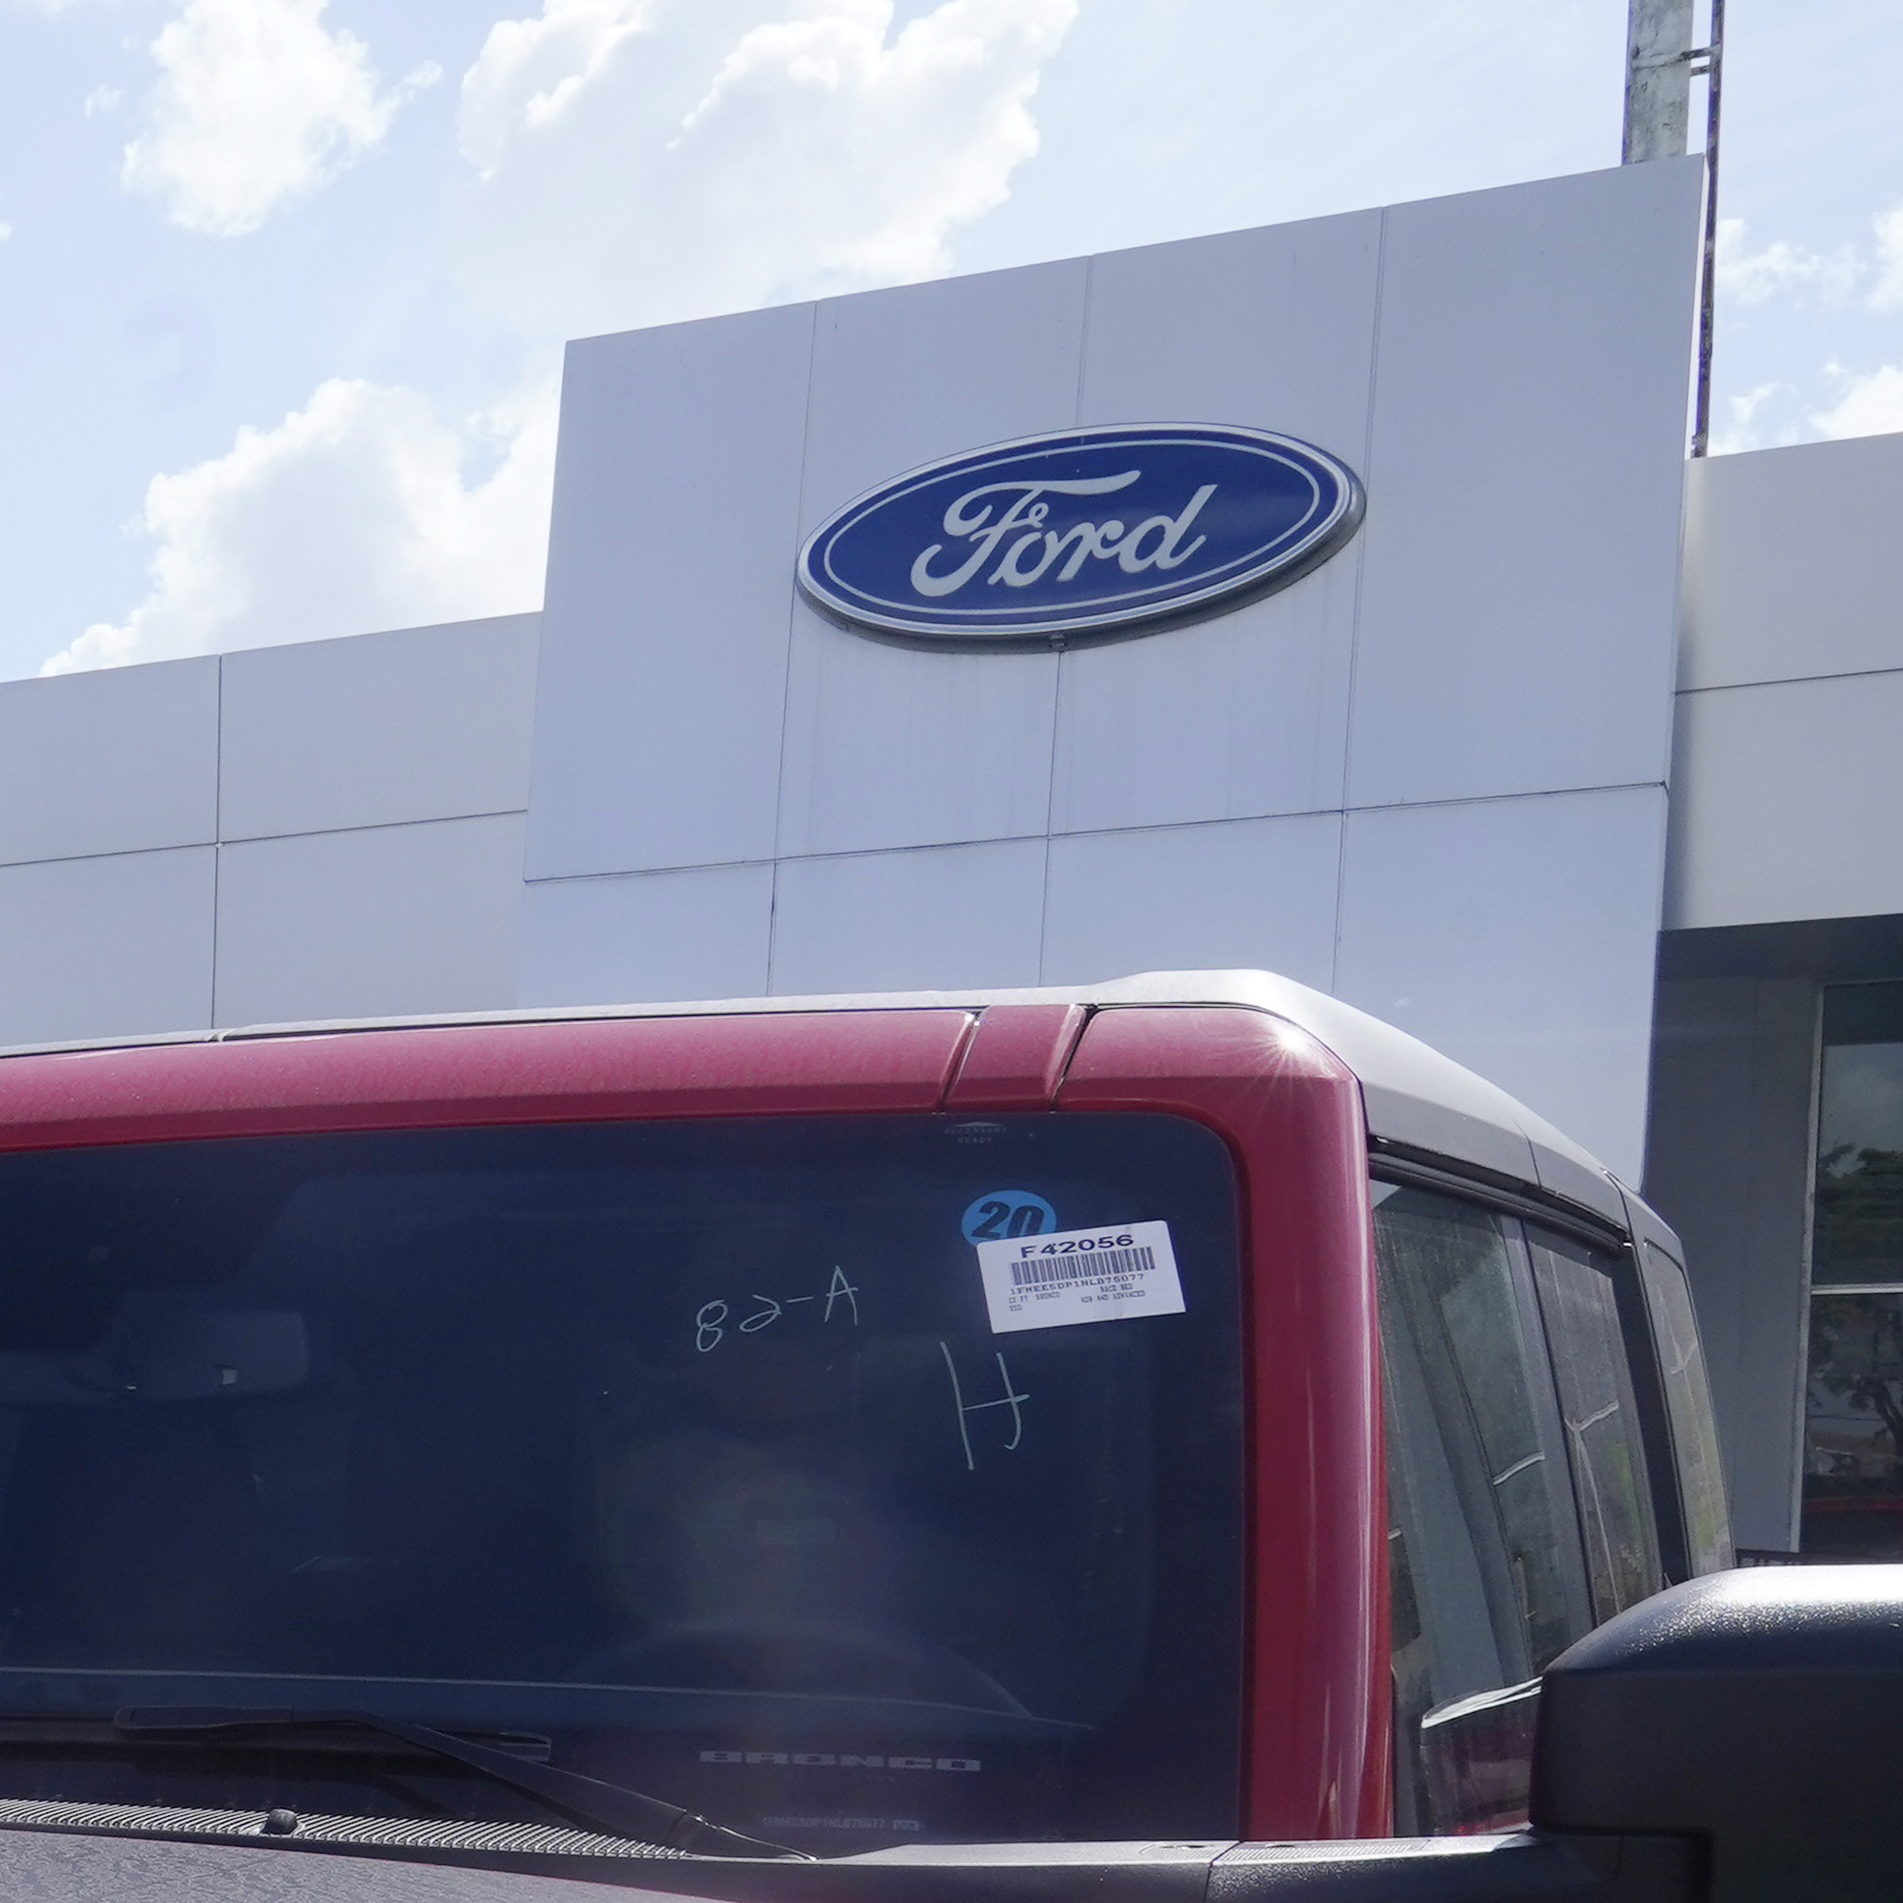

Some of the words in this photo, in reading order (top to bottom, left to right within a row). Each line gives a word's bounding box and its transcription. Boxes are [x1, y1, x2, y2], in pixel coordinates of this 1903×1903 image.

[909, 469, 1218, 598] Ford
[971, 1200, 1044, 1240] 20
[1020, 1234, 1135, 1259] F42056
[699, 1750, 982, 1772] BRONCO
